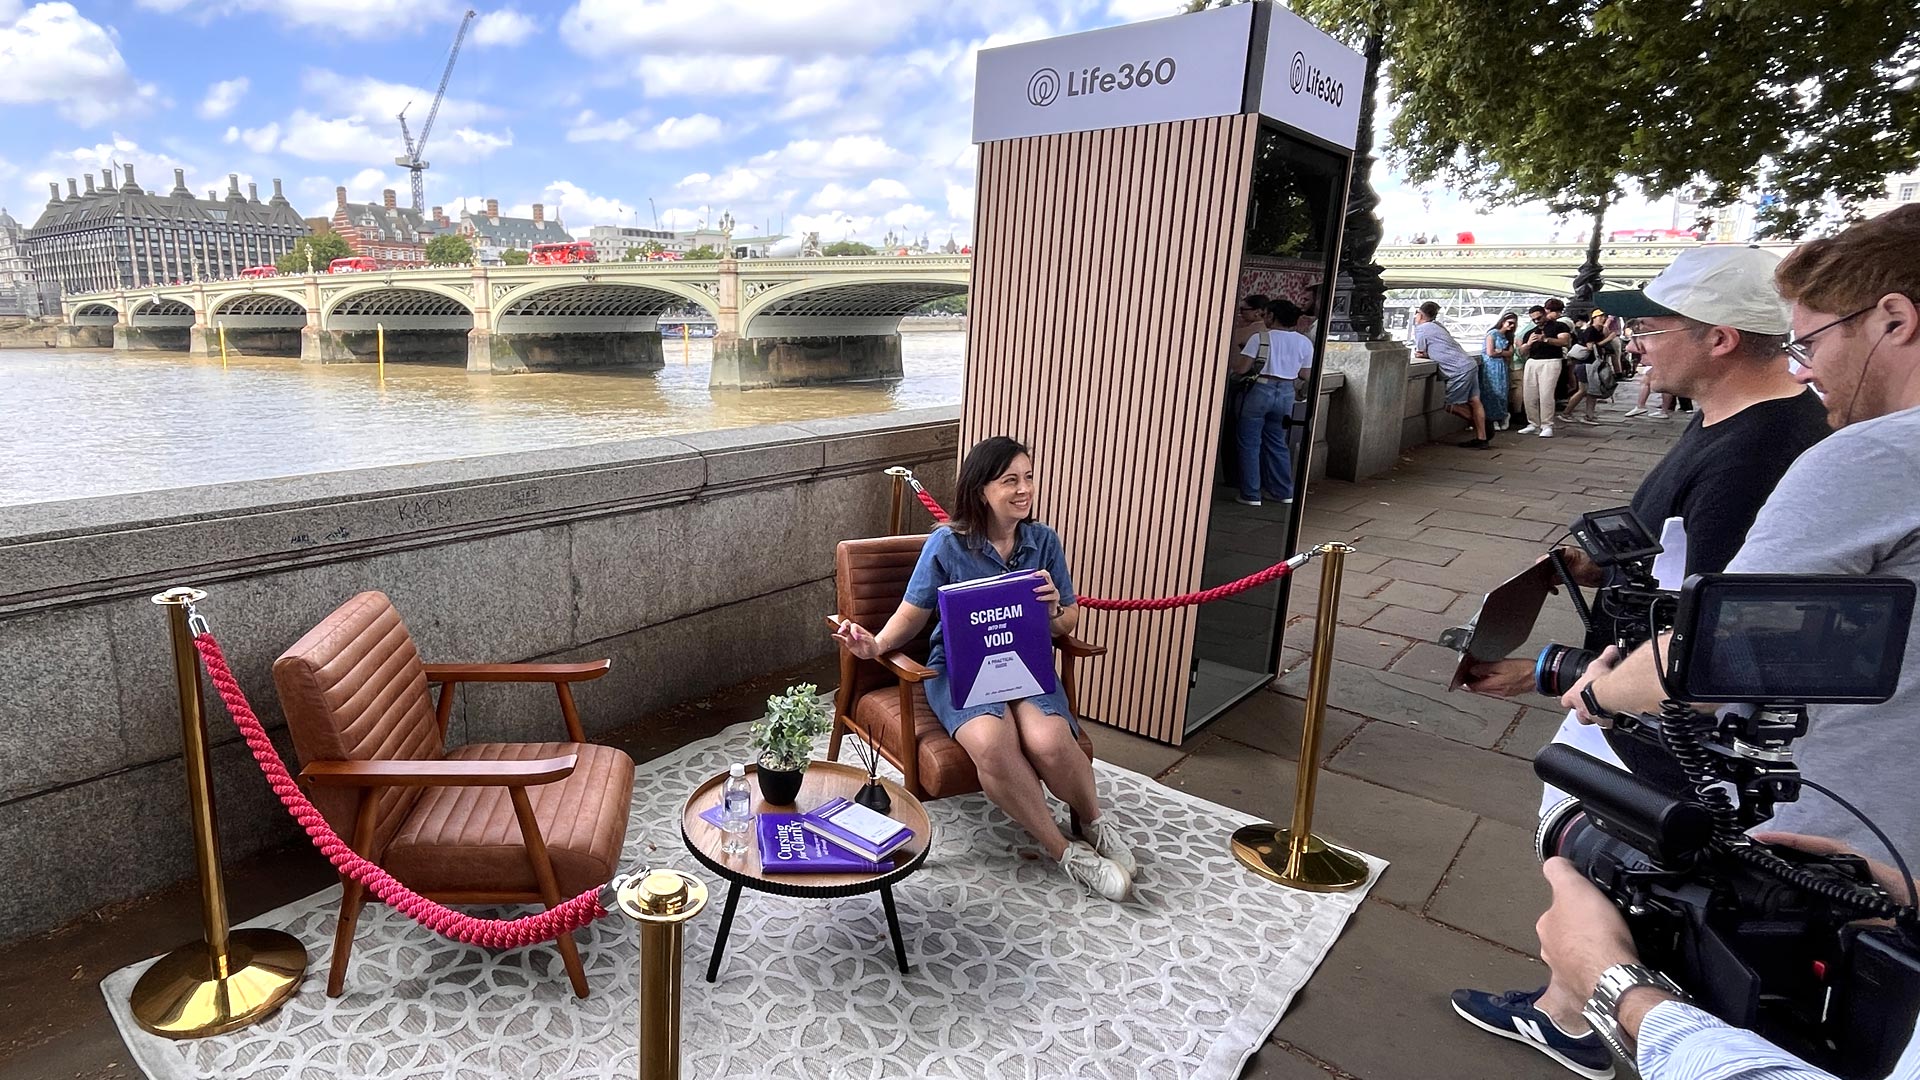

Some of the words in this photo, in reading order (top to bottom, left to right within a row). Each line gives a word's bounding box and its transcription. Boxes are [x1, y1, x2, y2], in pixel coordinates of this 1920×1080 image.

[1067, 57, 1176, 97] Life360
[1306, 65, 1344, 108] Life360
[970, 604, 1023, 625] SCREAM
[983, 631, 1014, 648] VOID
[775, 824, 793, 860] Cursing
[788, 820, 806, 852] Clarity
